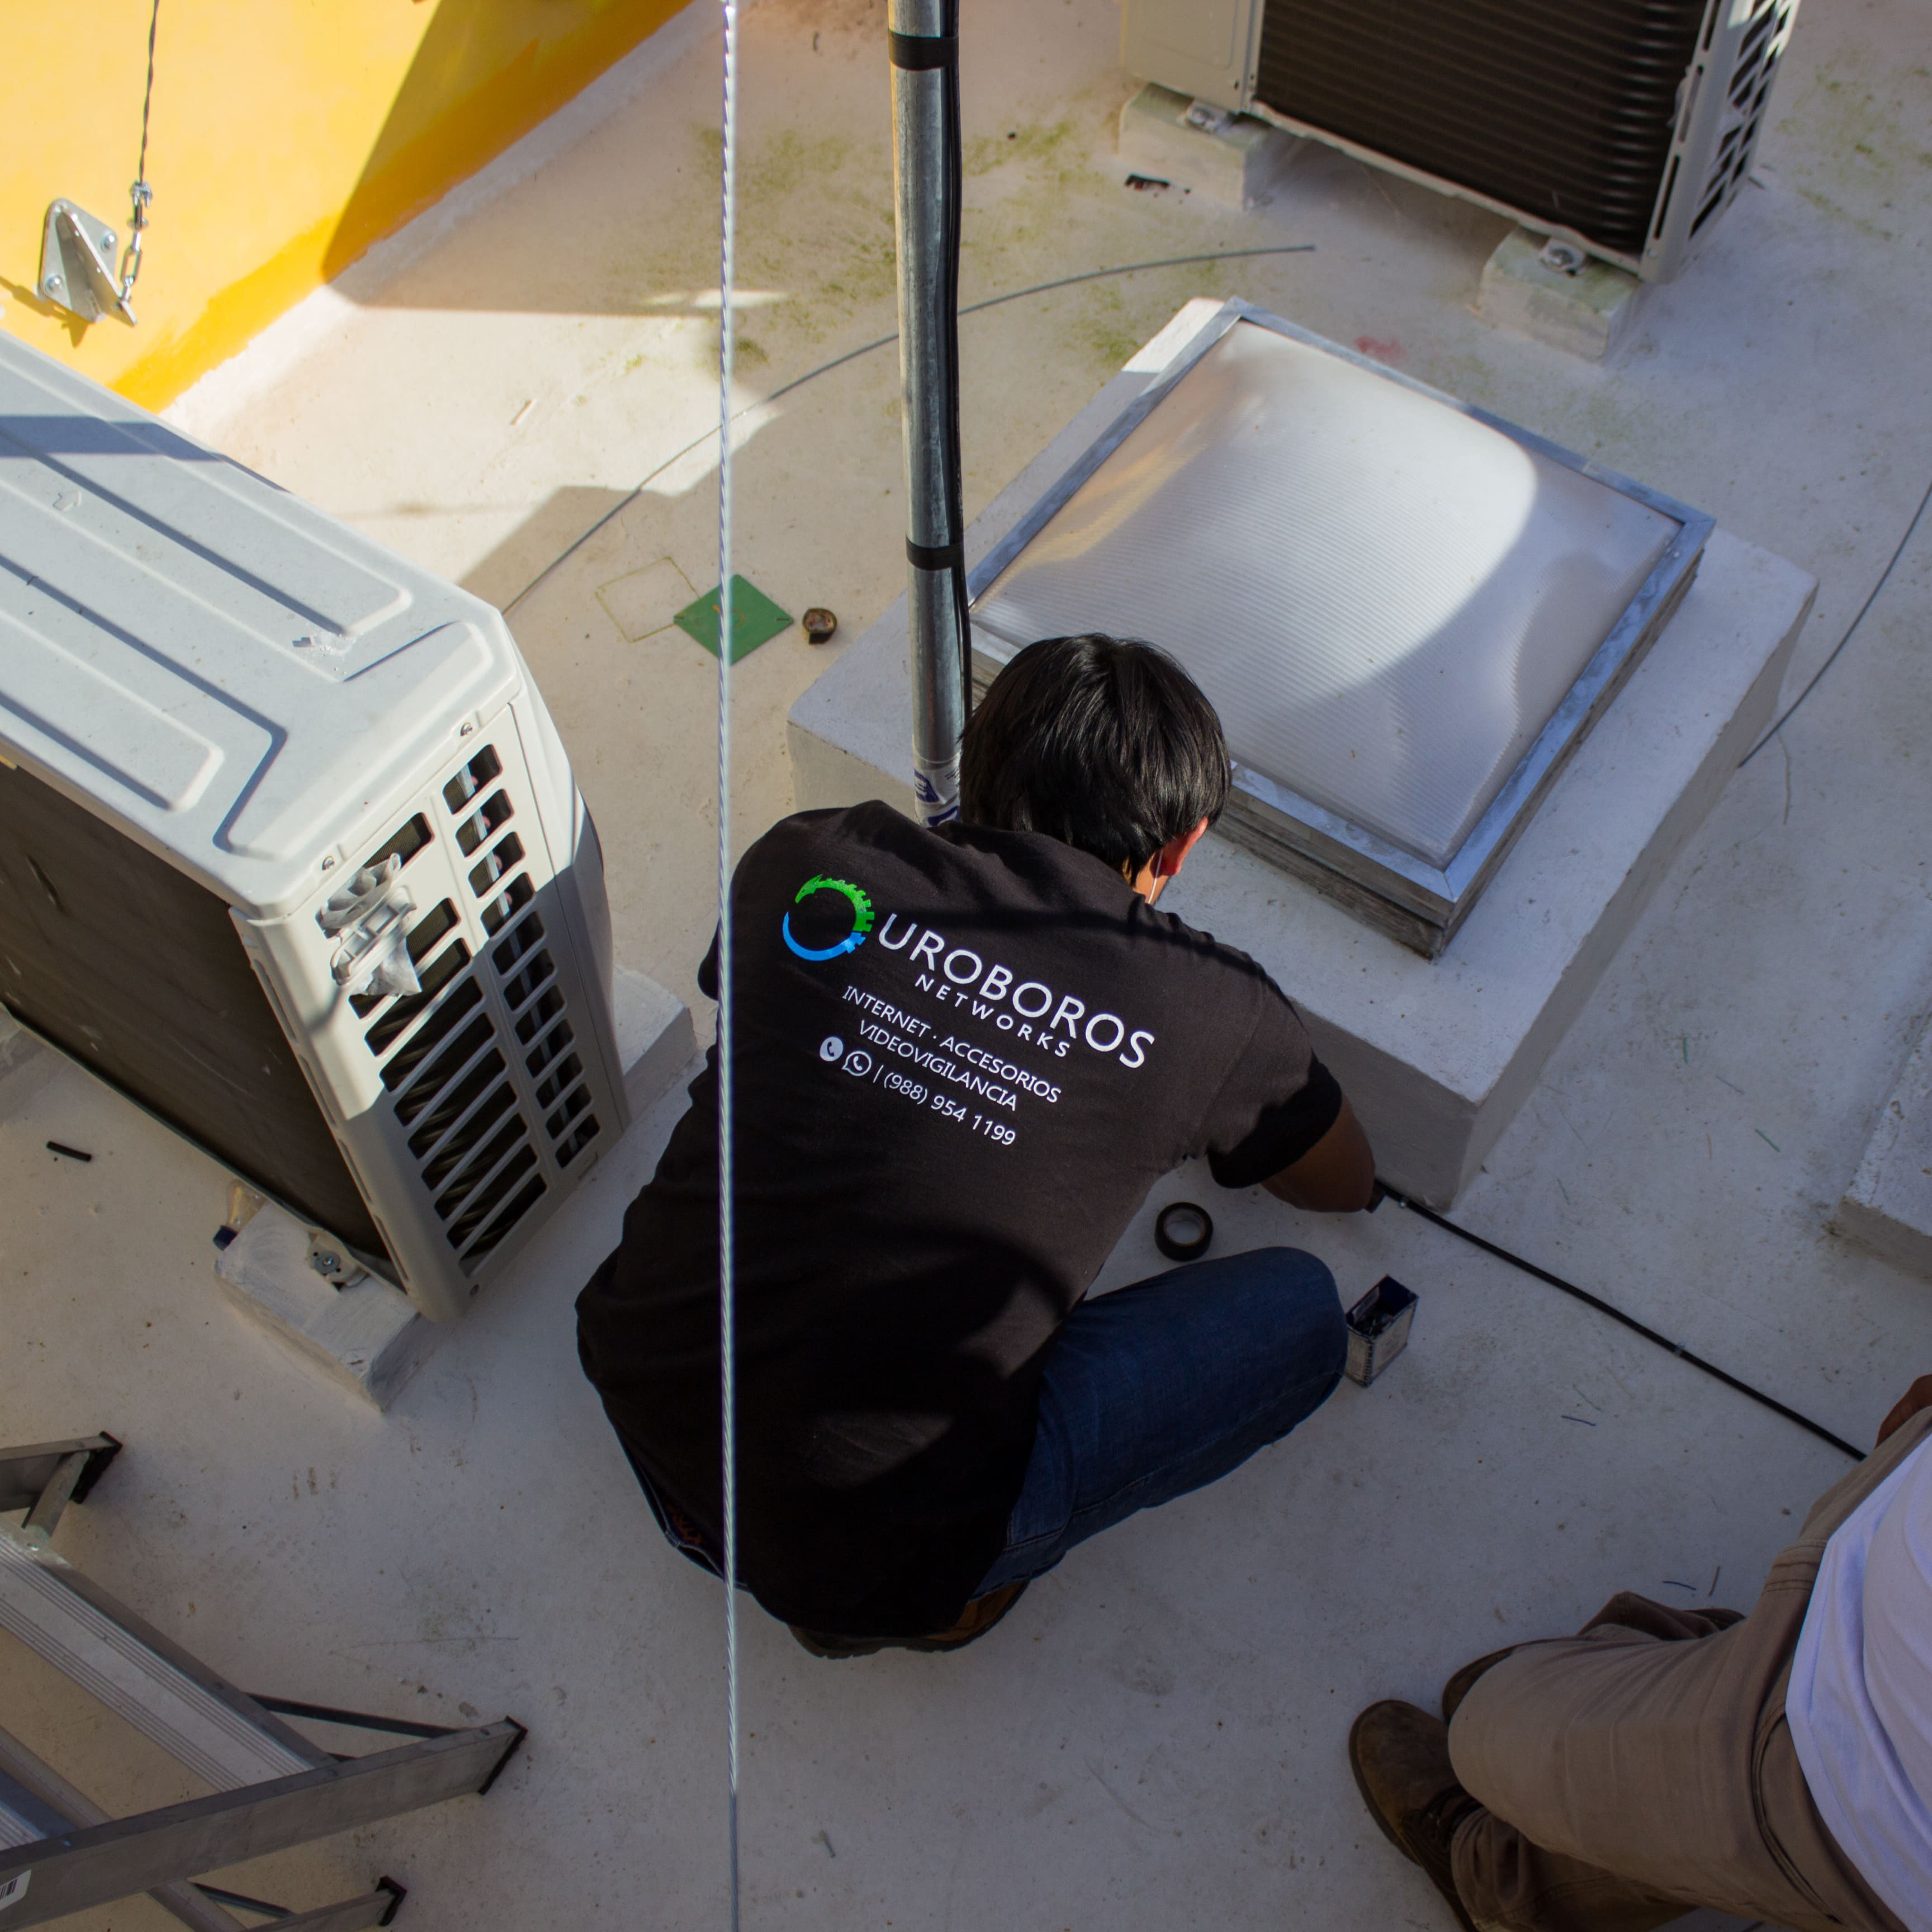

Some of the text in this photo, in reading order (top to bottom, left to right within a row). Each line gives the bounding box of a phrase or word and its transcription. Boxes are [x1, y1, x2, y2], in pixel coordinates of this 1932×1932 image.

[878, 913, 1155, 1068] UROBOROS
[915, 973, 1071, 1057] NETWORKS
[842, 986, 931, 1038] INTERNET
[939, 1036, 1062, 1103] ACCESORIOS
[860, 1019, 1017, 1112] VIDEOVIGILANCIA
[883, 1072, 928, 1105] (988)
[930, 1095, 967, 1123] 954
[972, 1115, 1016, 1145] 1199
